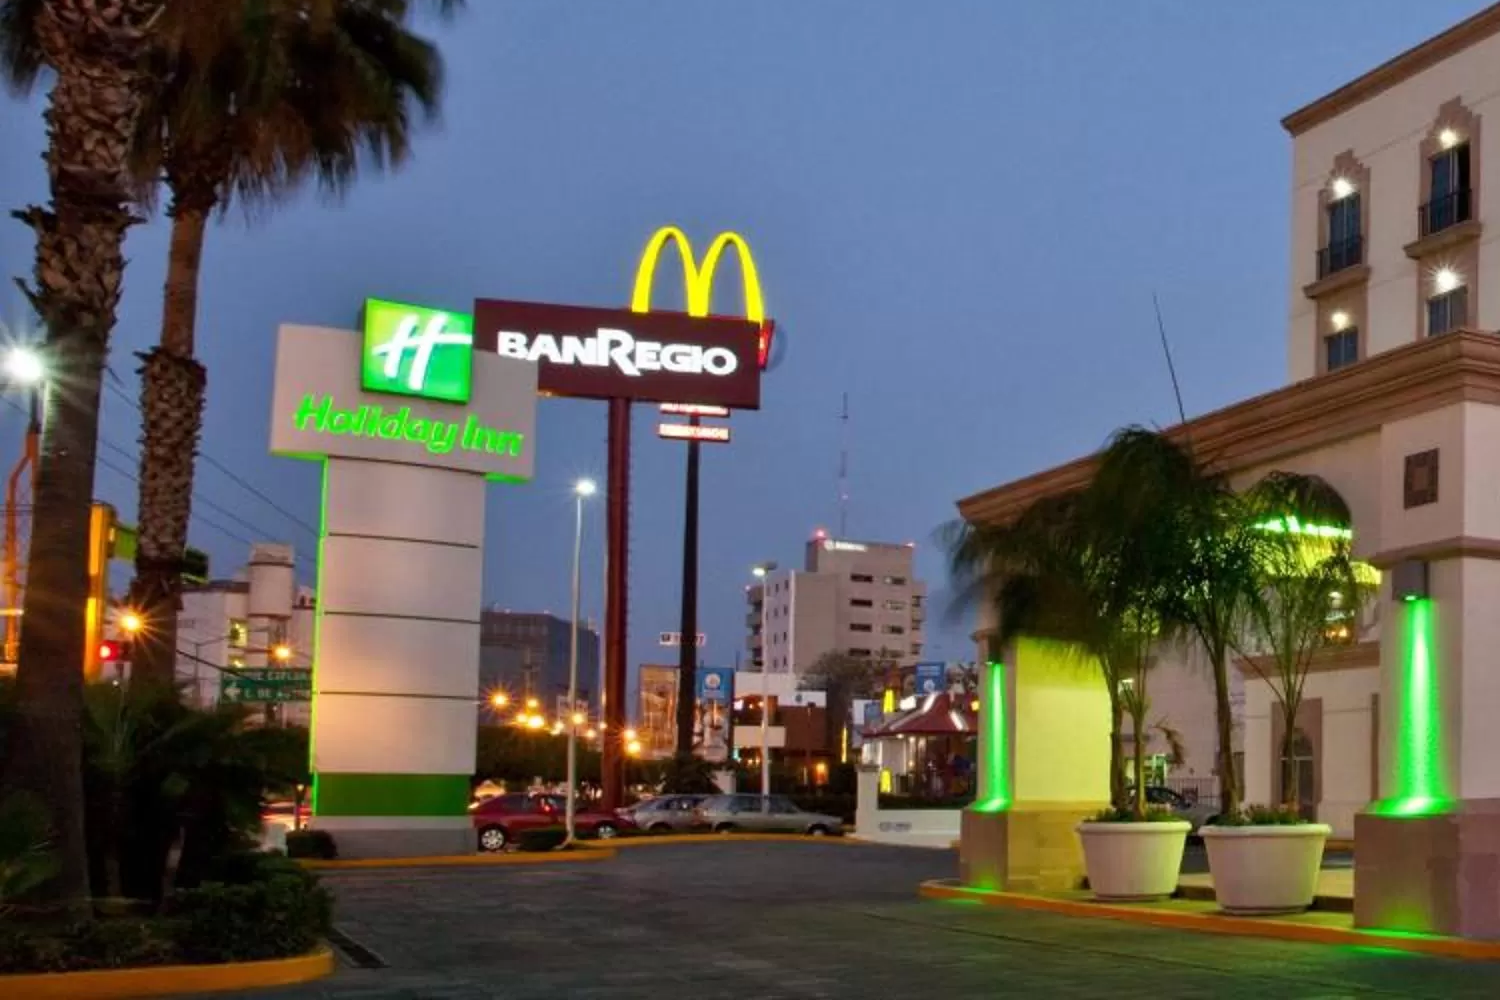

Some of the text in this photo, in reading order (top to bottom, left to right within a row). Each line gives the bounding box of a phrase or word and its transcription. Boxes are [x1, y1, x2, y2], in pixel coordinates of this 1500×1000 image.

[497, 327, 738, 377] BANREGIO
[293, 393, 524, 456] Holiday Inn
